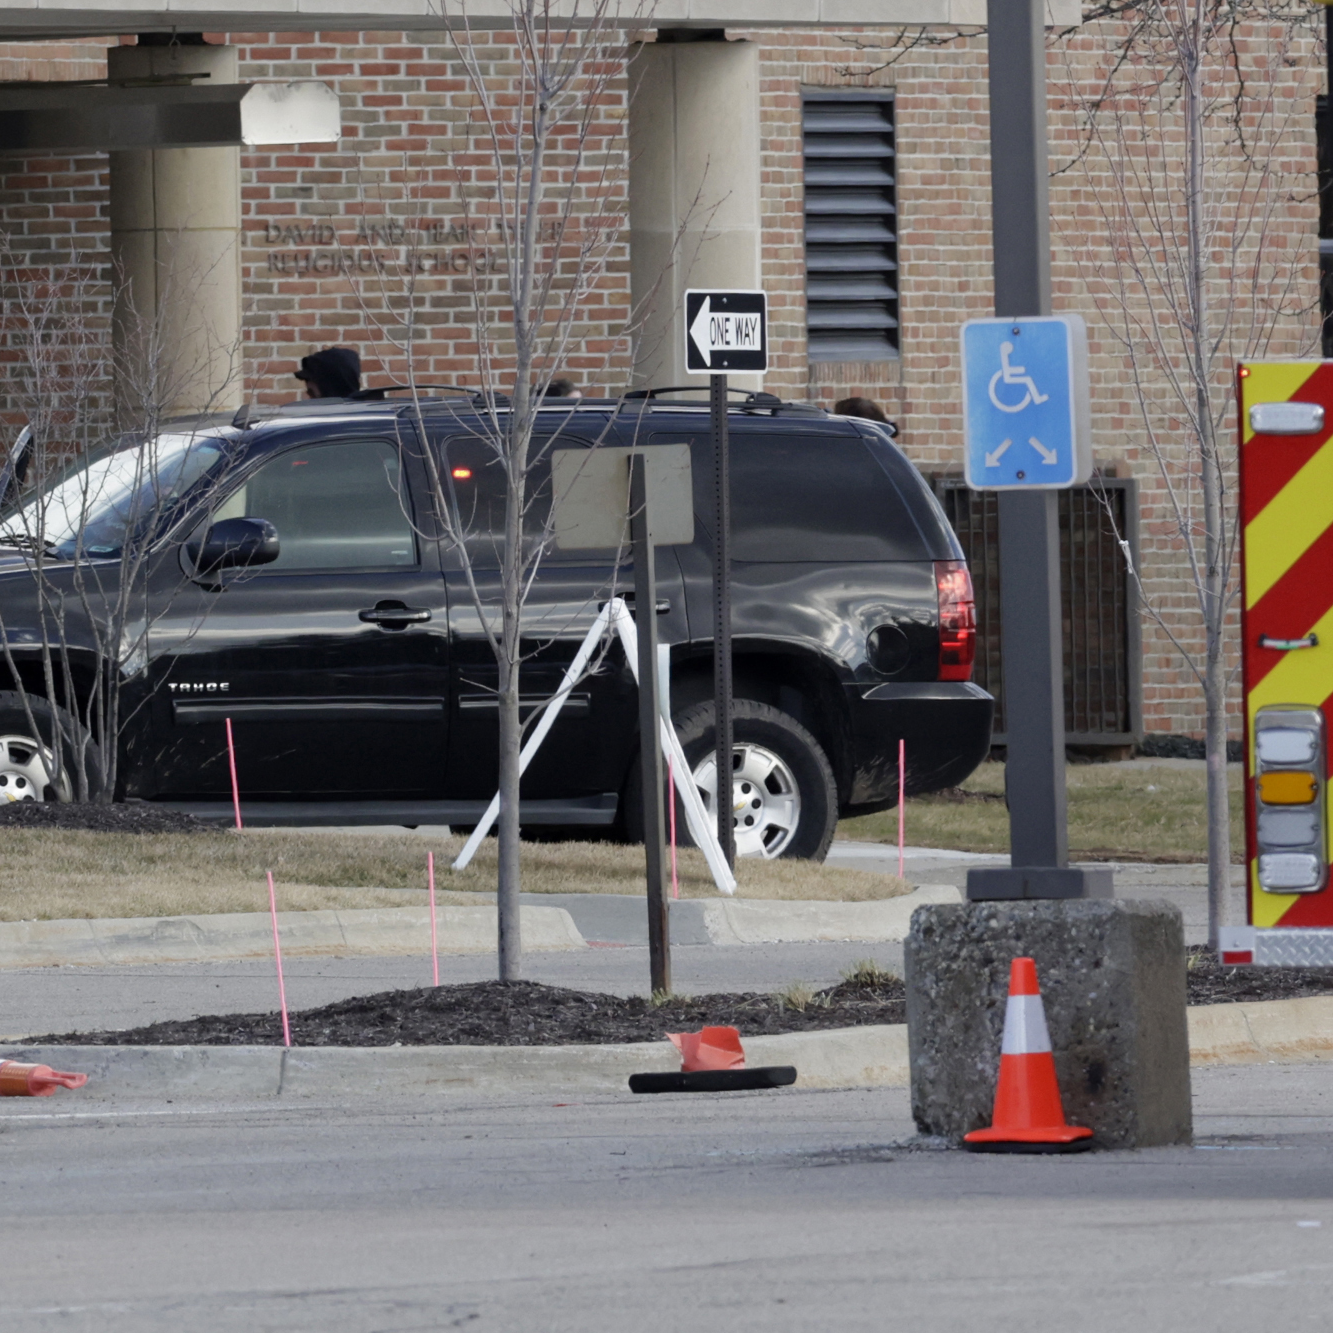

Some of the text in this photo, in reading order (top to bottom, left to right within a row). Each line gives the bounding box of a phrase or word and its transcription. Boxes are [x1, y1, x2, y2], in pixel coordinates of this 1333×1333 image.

[265, 221, 337, 245] DAVID
[356, 222, 406, 245] AND
[267, 252, 501, 274] RELIGIOUS SCHOOL
[710, 317, 757, 346] ONE WAY
[168, 682, 230, 692] TAHOE
